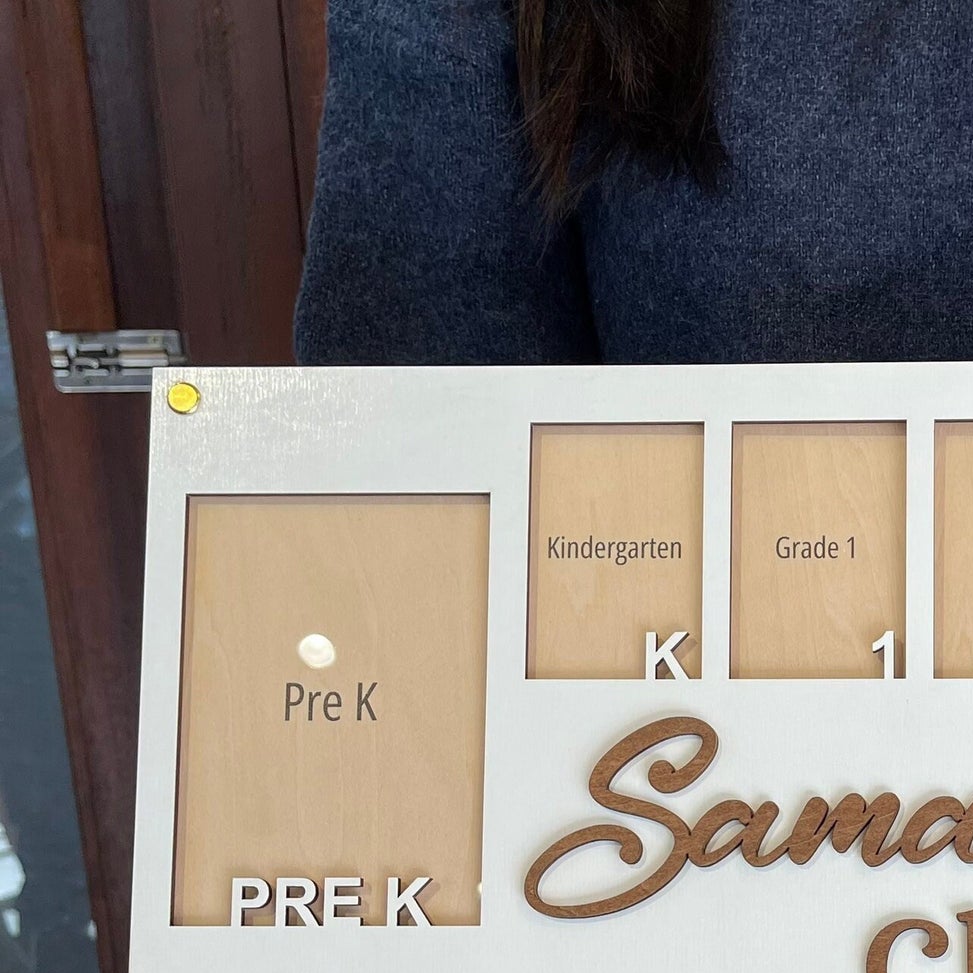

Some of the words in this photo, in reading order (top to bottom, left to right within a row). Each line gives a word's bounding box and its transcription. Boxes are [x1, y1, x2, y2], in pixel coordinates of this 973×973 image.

[546, 535, 683, 566] Kindergarten
[775, 535, 839, 559] Grade
[845, 536, 858, 559] 1
[645, 631, 692, 679] K
[871, 630, 896, 679] 1
[284, 682, 343, 722] Pre
[356, 682, 379, 722] K
[231, 877, 364, 927] PRE
[386, 877, 433, 927] K
